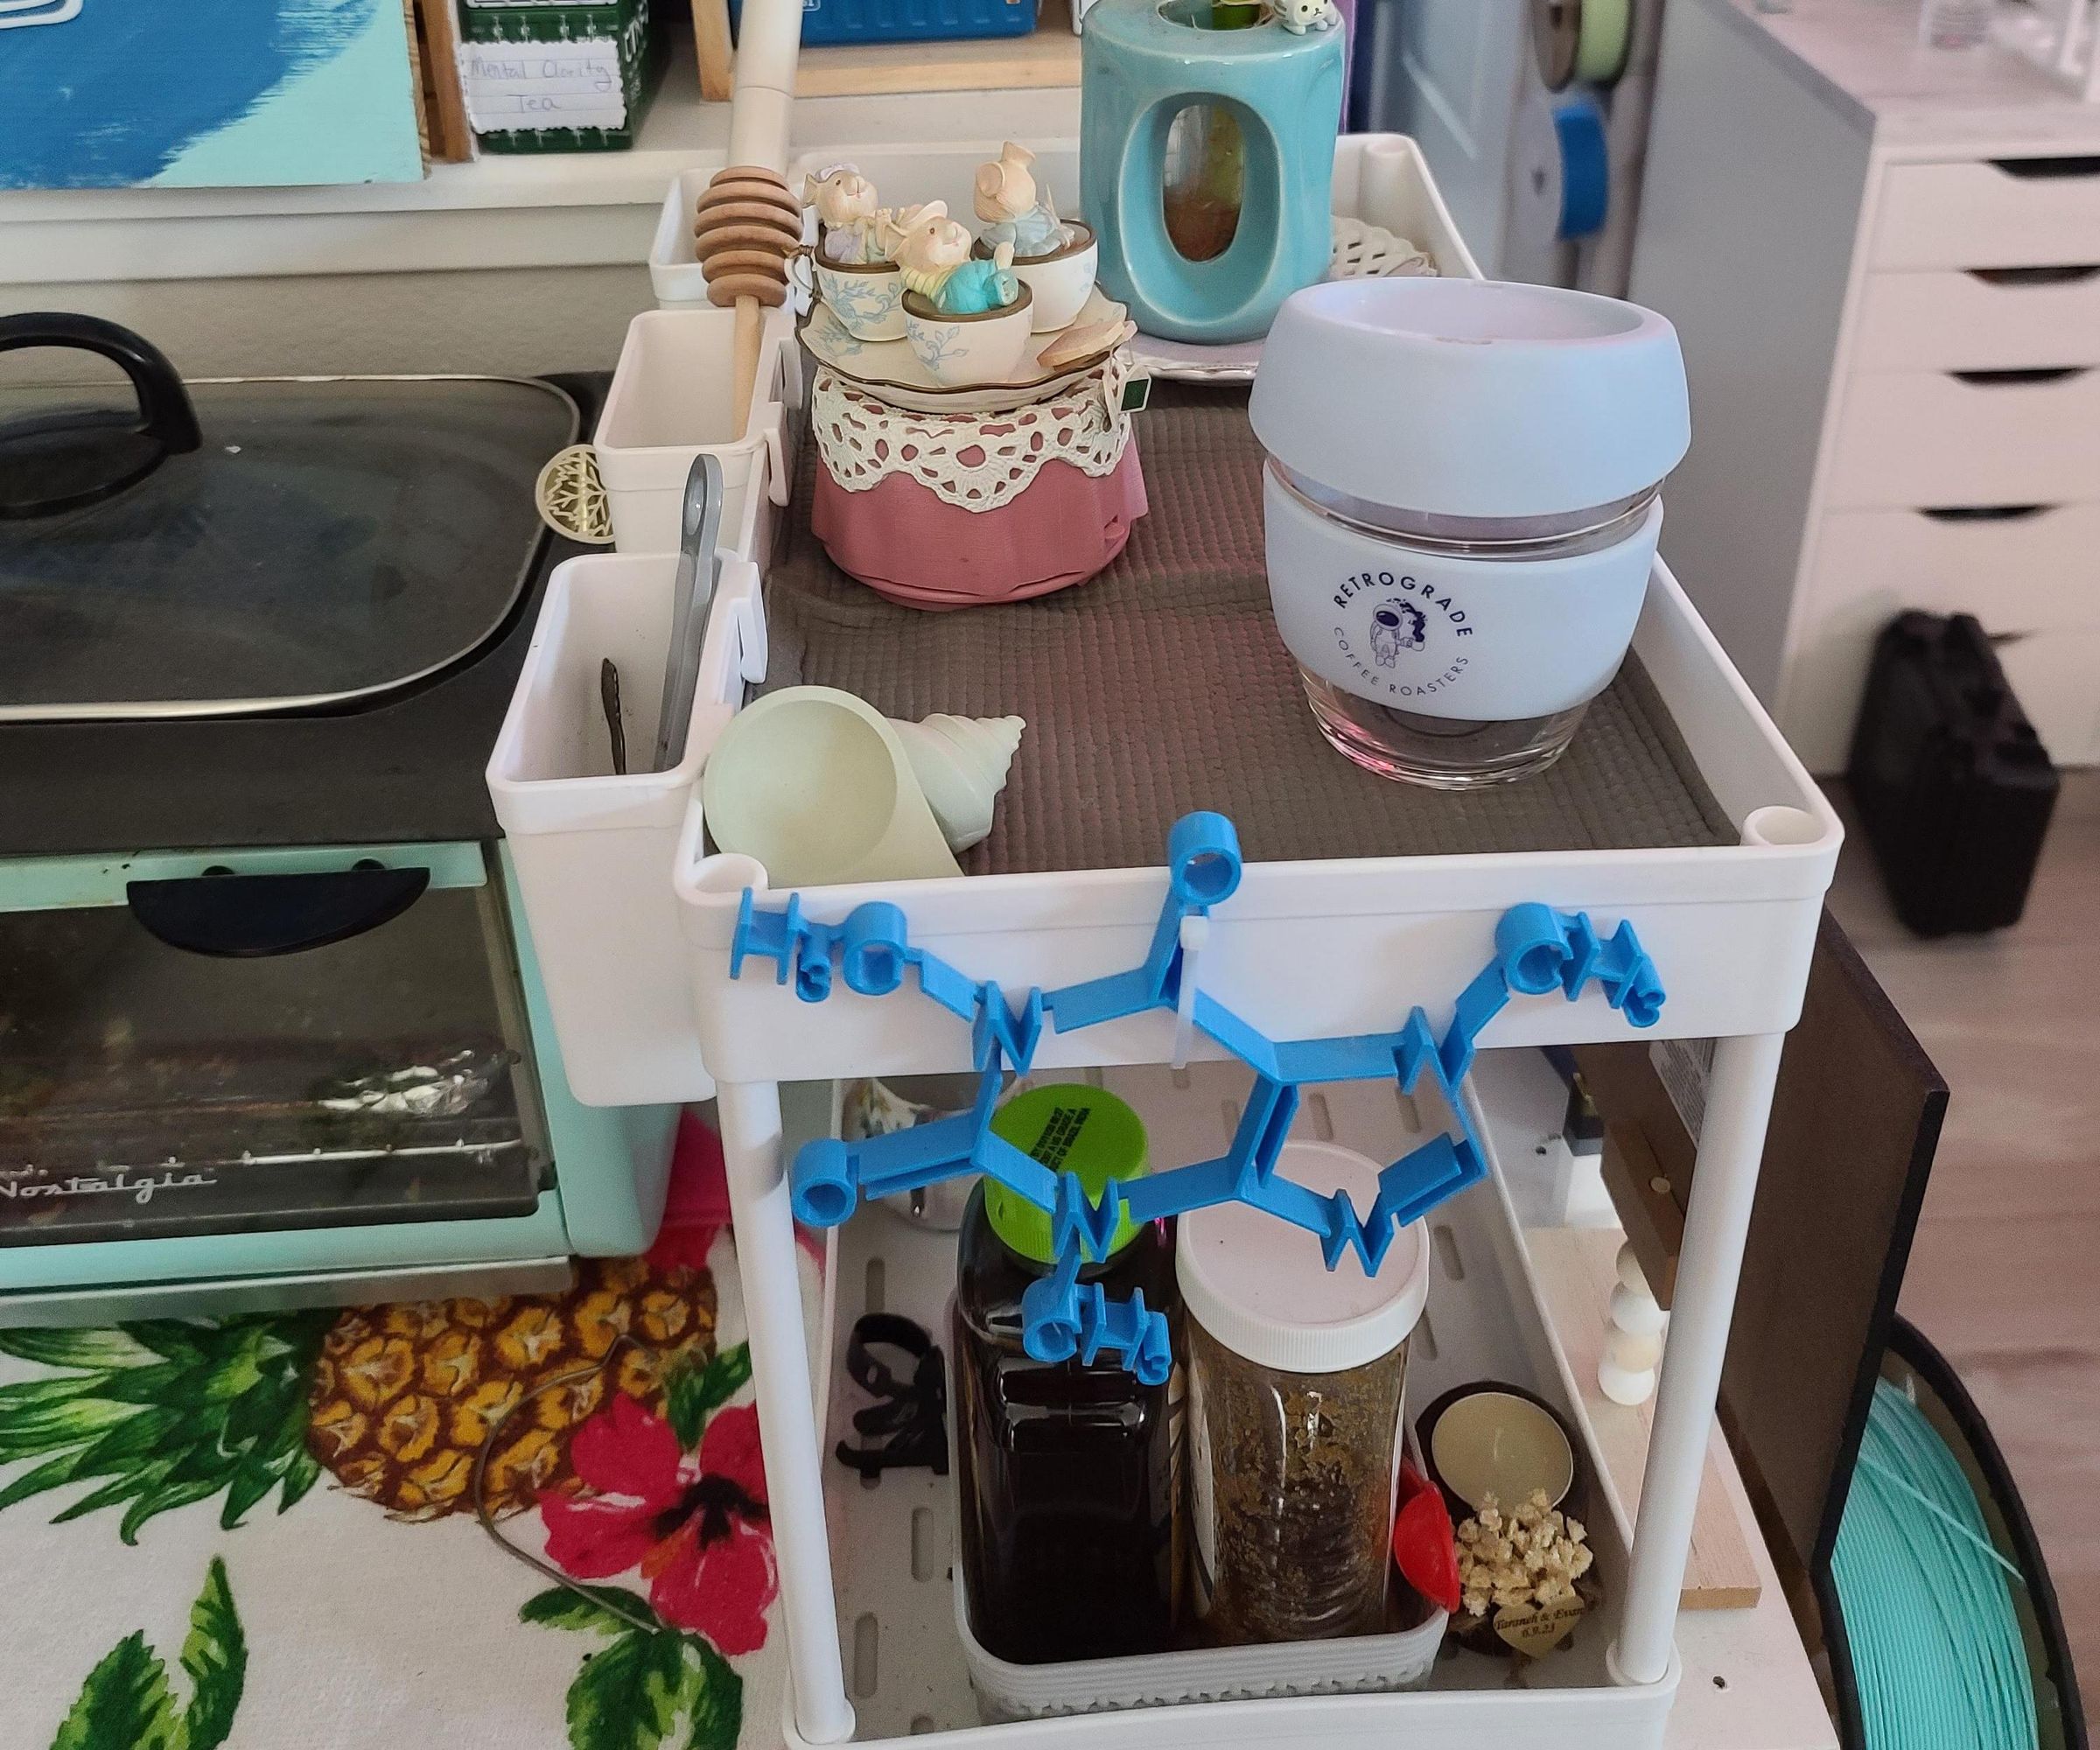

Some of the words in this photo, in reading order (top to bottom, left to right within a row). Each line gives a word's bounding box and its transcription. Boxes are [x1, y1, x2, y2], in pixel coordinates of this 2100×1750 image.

[471, 57, 528, 80] Mental
[542, 57, 612, 91] Clarity
[507, 94, 561, 113] Tea
[1334, 571, 1473, 637] RETROGRADE
[1334, 627, 1380, 685] COFFEE
[1389, 656, 1469, 696] ROASTERS
